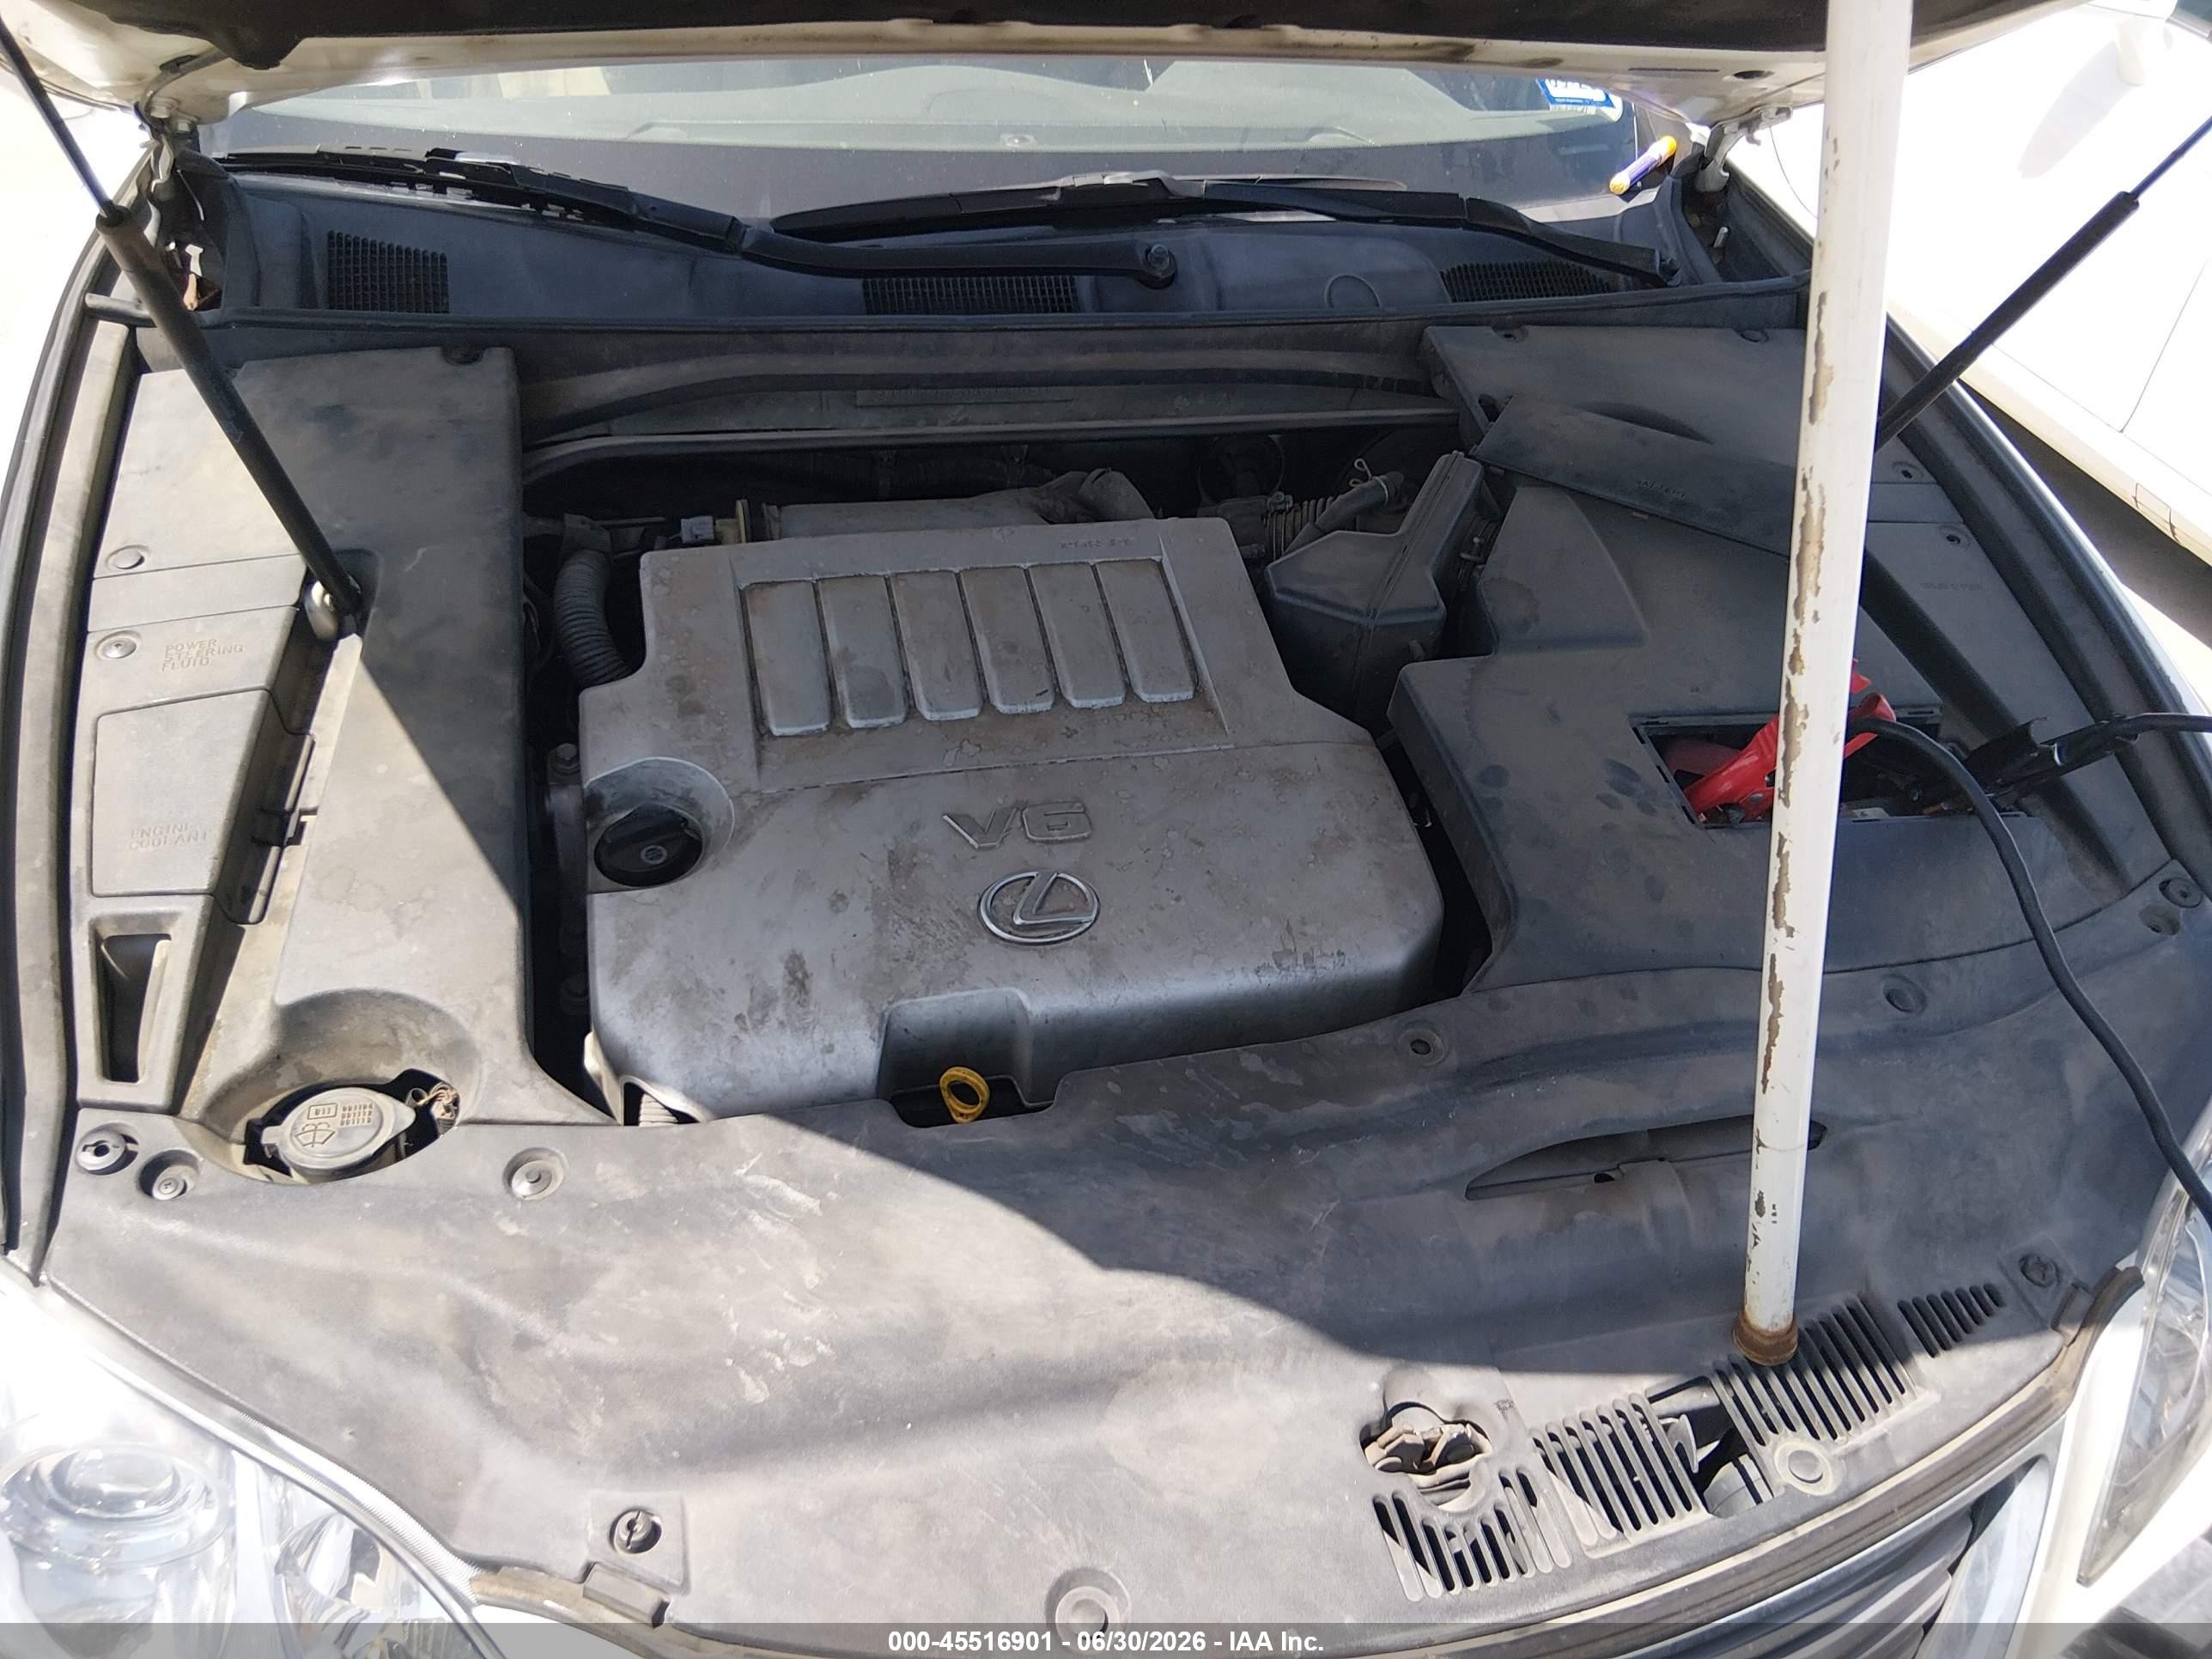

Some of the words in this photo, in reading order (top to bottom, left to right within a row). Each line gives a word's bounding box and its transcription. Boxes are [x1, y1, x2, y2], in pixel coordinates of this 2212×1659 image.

[164, 645, 245, 663] STEERING
[166, 638, 217, 655] POWER
[162, 658, 210, 672] FLUID
[943, 801, 1092, 850] V6
